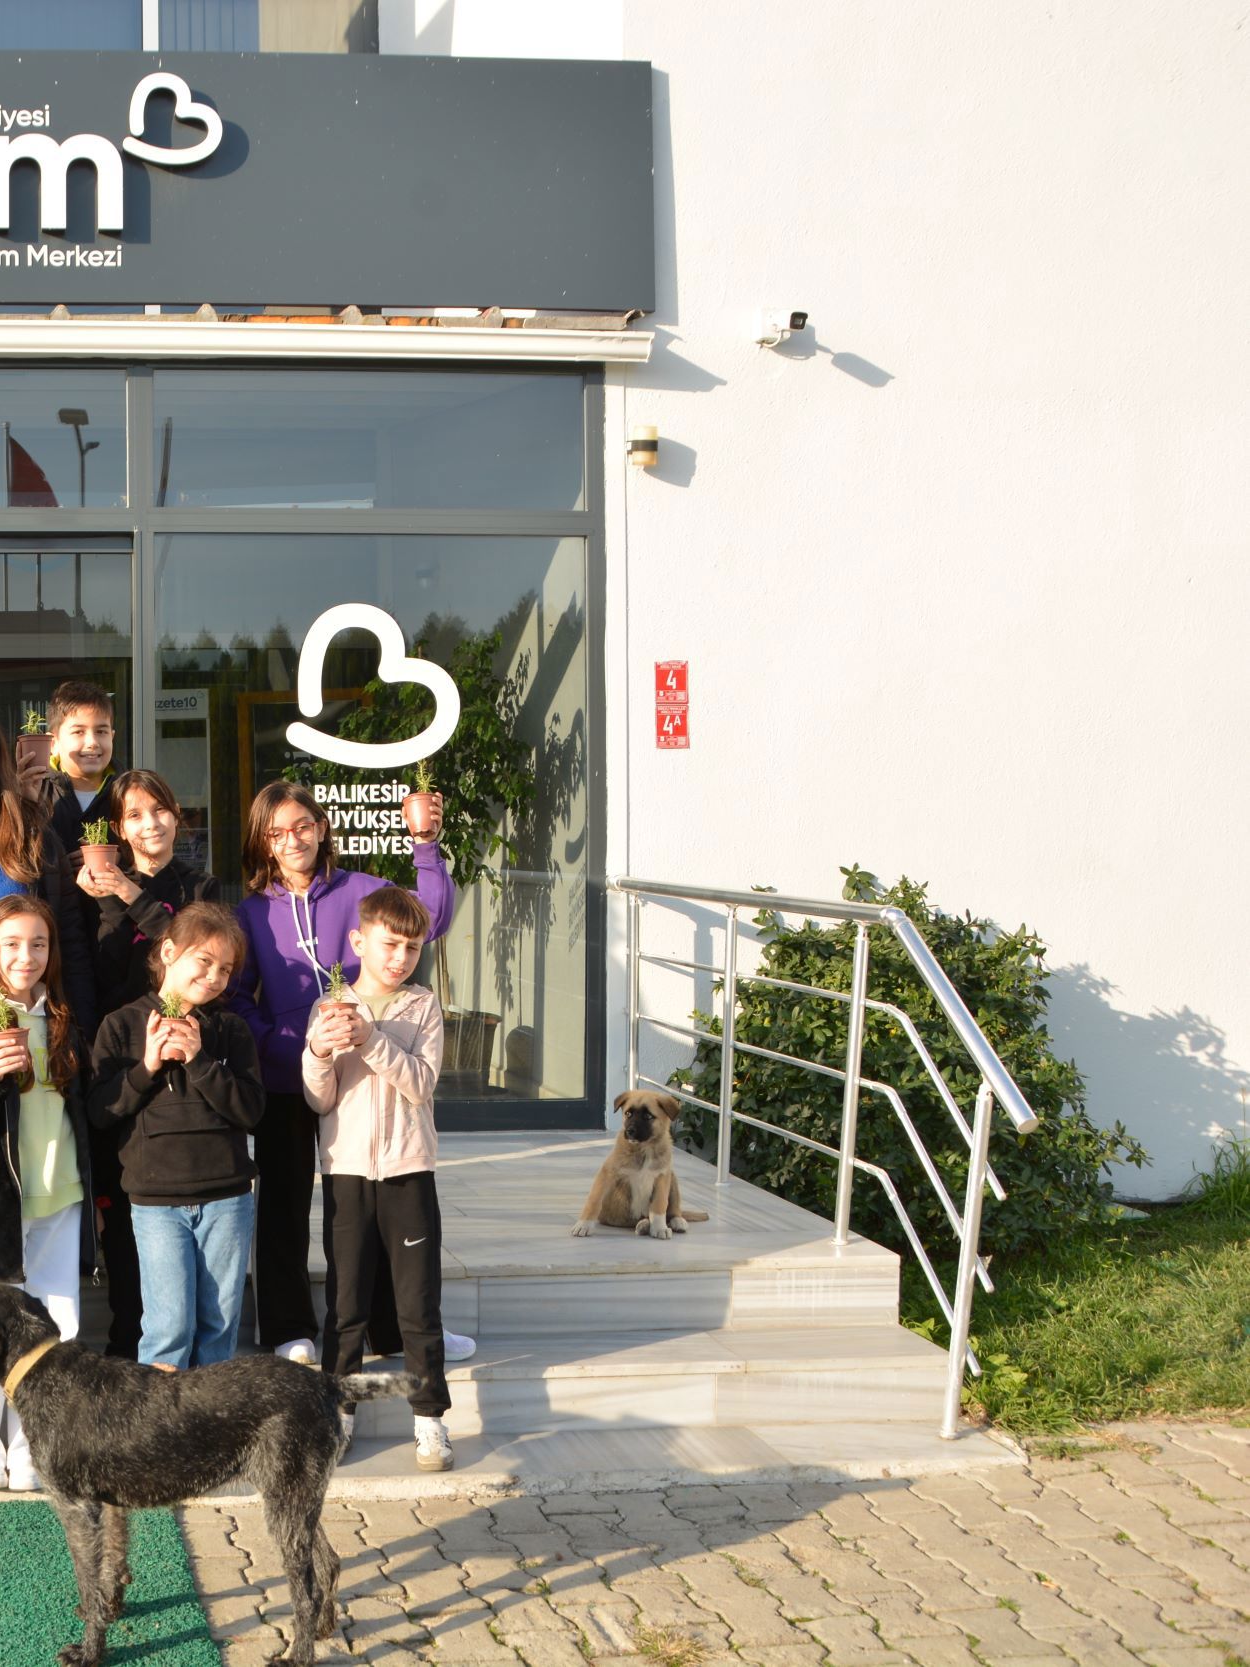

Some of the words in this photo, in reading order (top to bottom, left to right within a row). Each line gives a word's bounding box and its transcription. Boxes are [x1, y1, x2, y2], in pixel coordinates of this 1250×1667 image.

[27, 244, 123, 267] Merkezi
[666, 669, 677, 690] 4
[155, 697, 198, 709] zete10
[327, 805, 408, 833] ÜYÜKŞE
